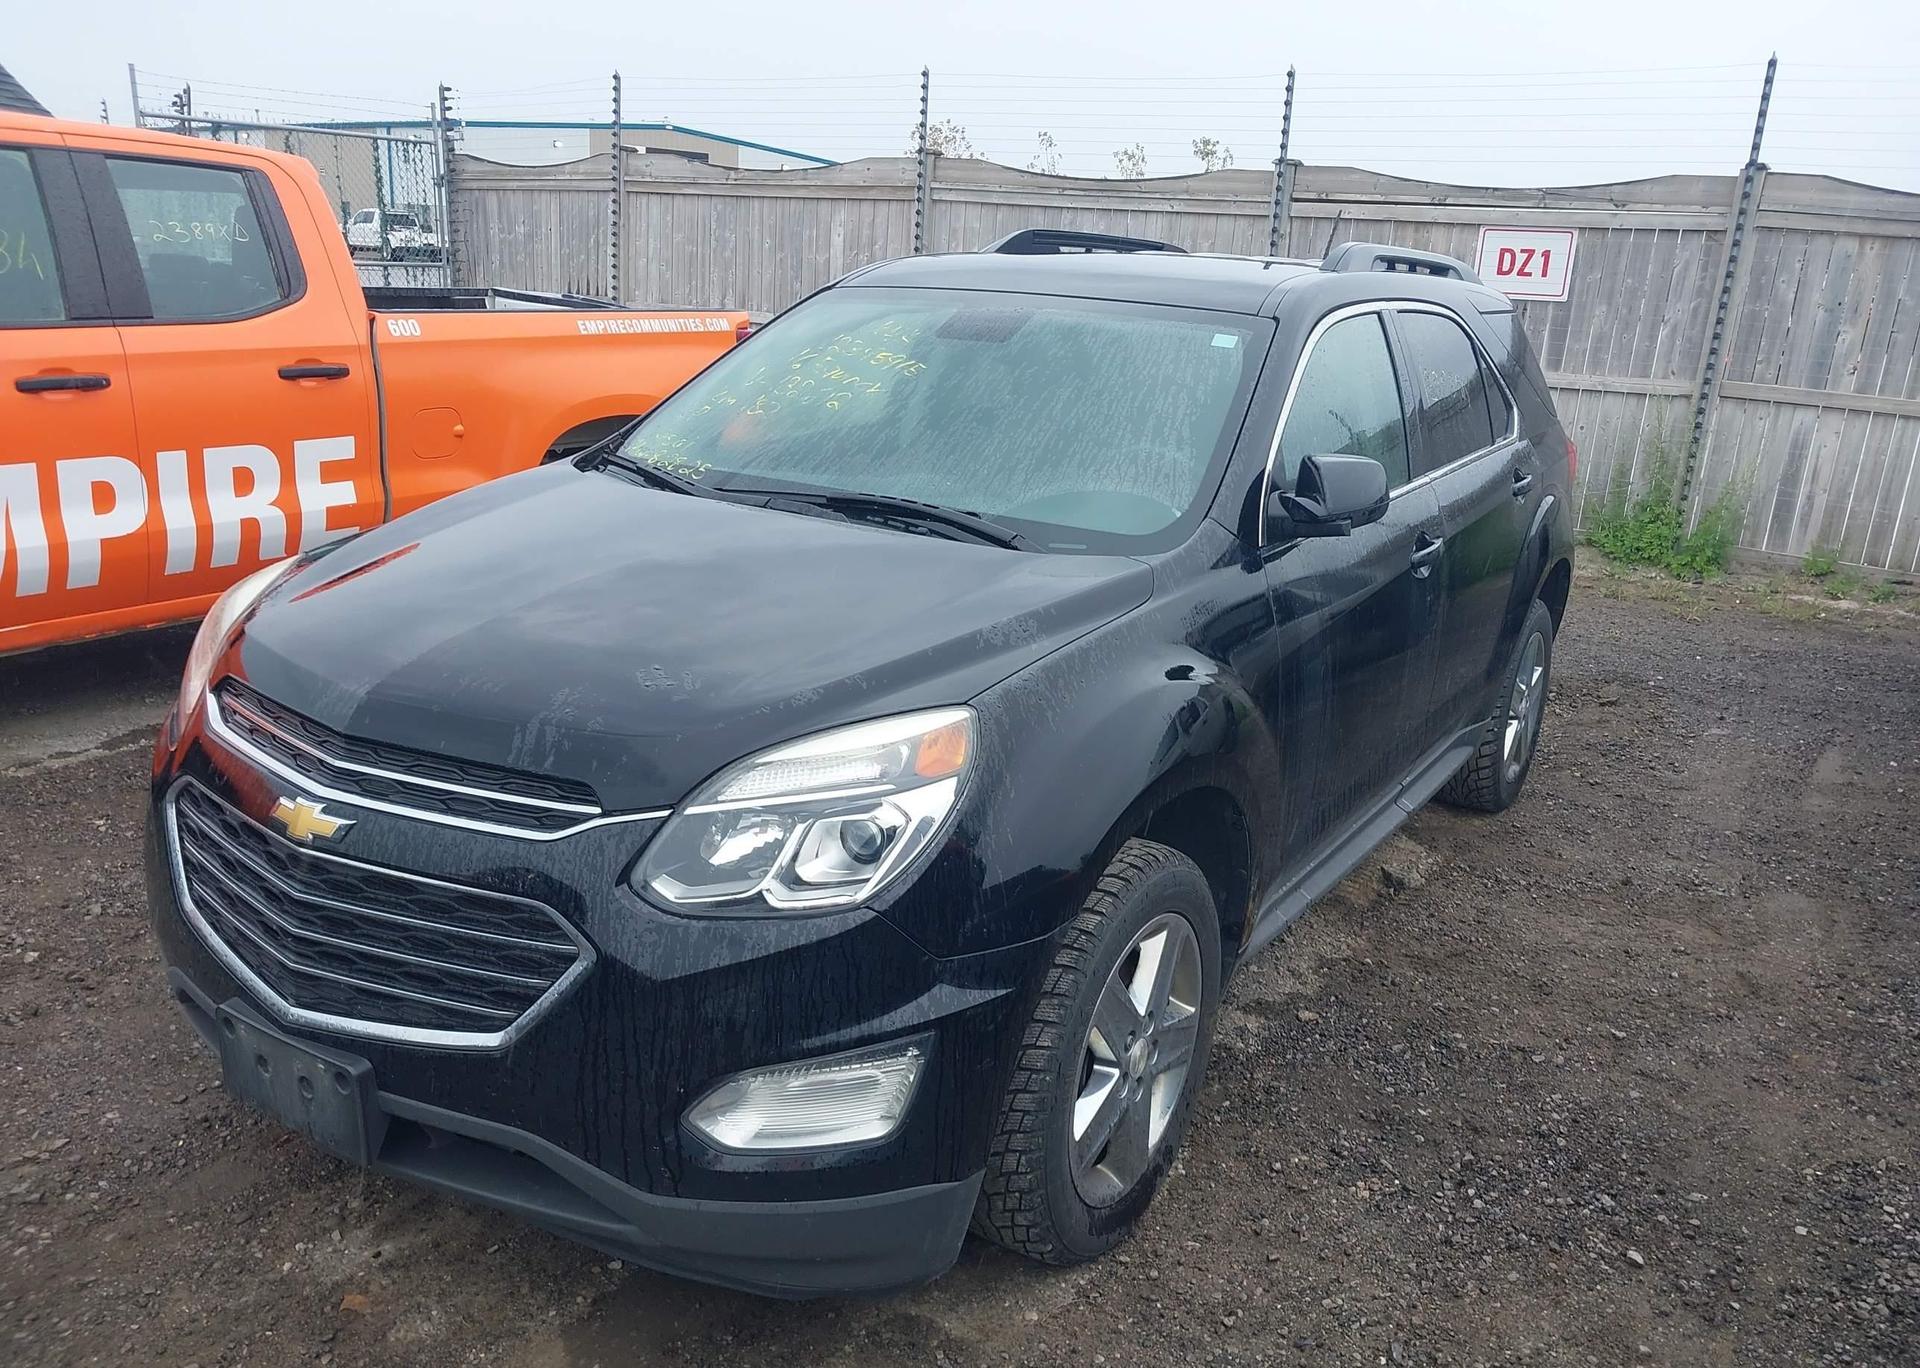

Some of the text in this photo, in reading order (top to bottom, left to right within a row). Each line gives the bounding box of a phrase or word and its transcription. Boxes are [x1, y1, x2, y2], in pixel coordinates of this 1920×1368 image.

[1496, 247, 1552, 278] DZ1
[386, 318, 422, 337] 600
[576, 318, 731, 335] EMPIRECOMMUNITIES.COM
